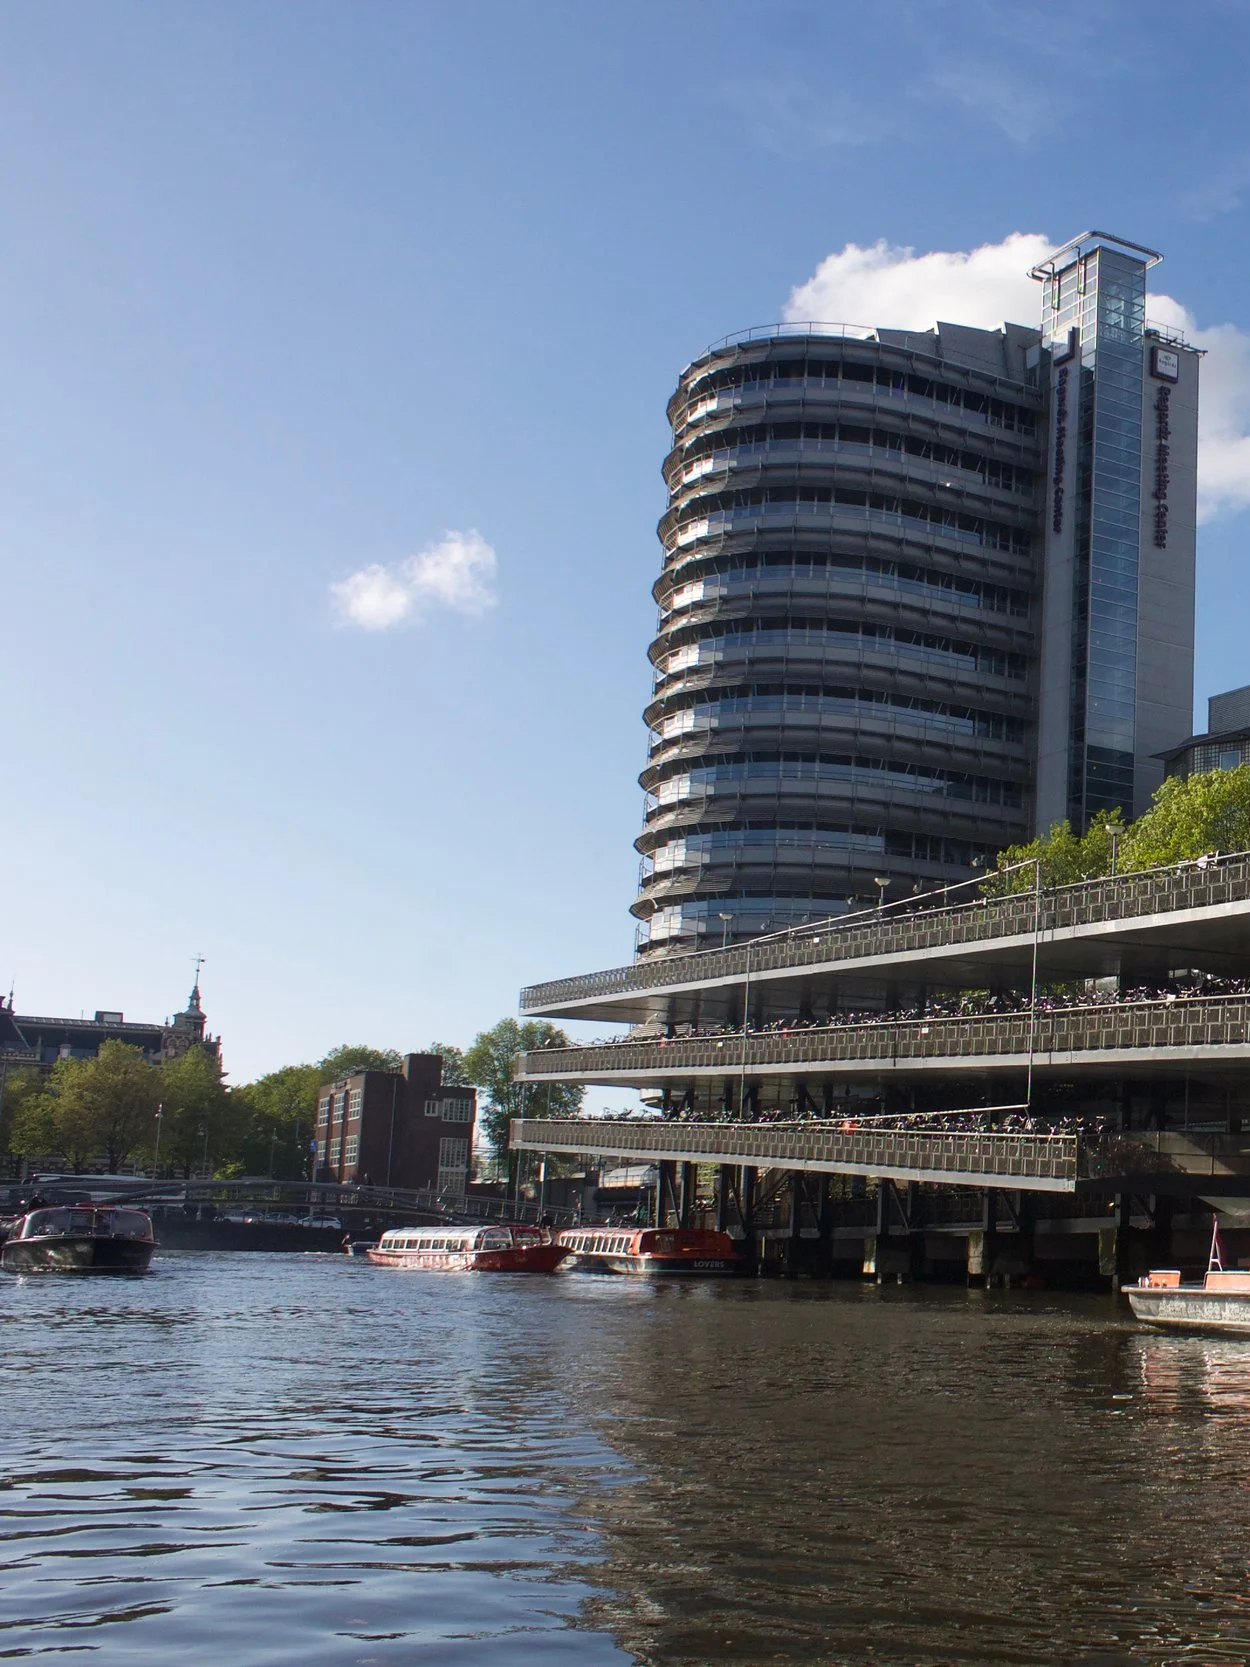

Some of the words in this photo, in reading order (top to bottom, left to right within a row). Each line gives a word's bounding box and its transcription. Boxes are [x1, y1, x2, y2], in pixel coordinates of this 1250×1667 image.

[1053, 426, 1066, 486] Meeting
[1153, 443, 1170, 501] Meeting
[1154, 503, 1169, 550] Center
[693, 1260, 725, 1268] LOVERS
